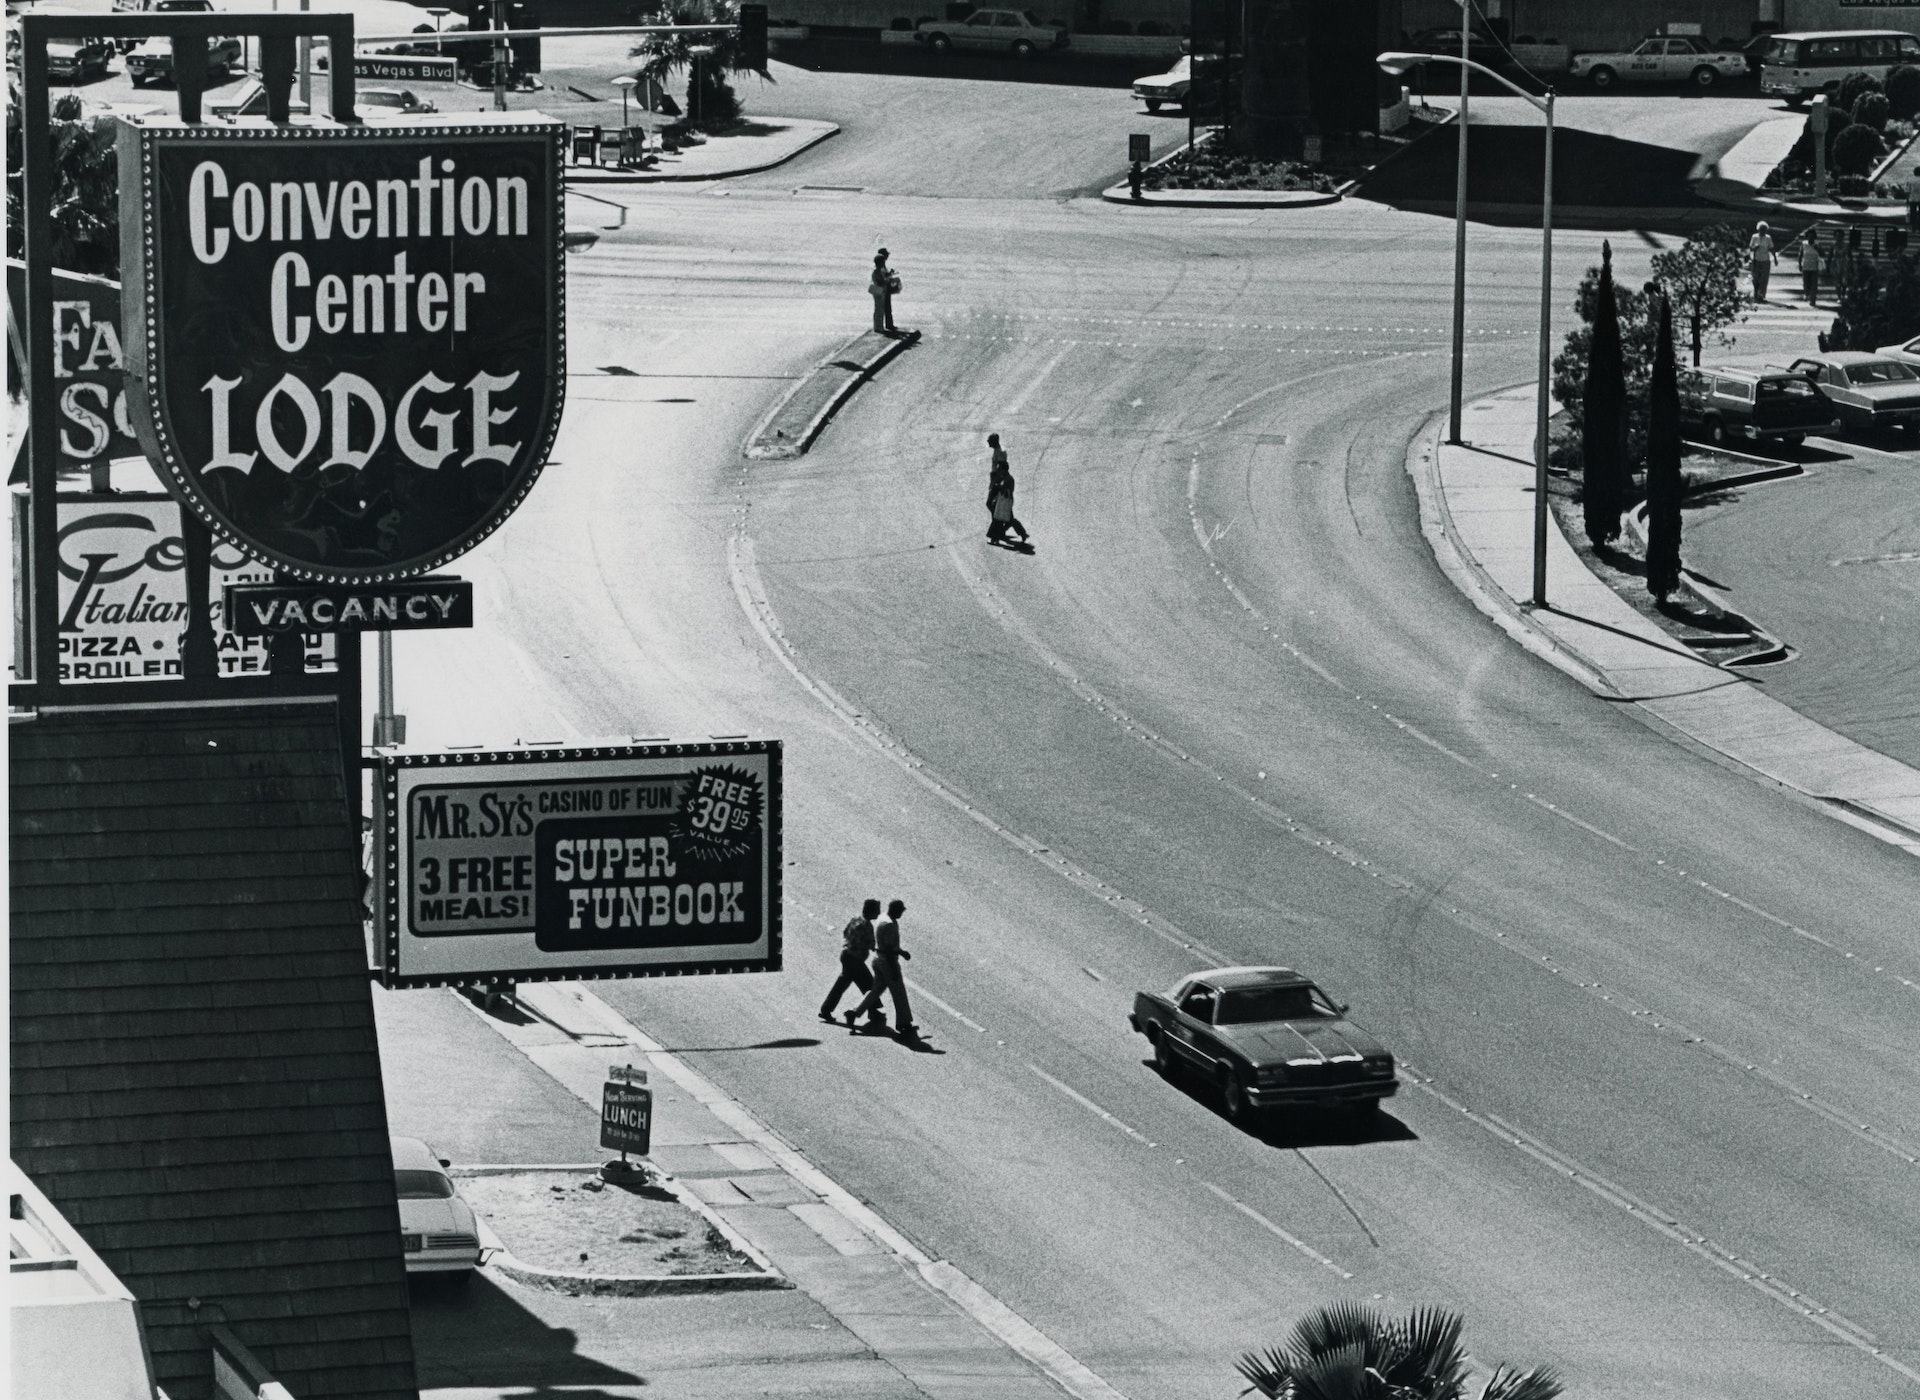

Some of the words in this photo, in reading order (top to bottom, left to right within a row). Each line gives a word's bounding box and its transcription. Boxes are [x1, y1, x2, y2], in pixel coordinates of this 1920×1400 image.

[372, 64, 414, 79] Vegas
[422, 66, 452, 78] Blvd
[189, 155, 529, 264] Convention
[270, 250, 486, 353] Center
[200, 370, 523, 475] LODGE
[250, 594, 459, 626] VACANCY
[538, 790, 603, 814] CASINO
[608, 788, 631, 811] OF
[636, 786, 673, 808] FUN
[697, 774, 753, 806] FREE
[689, 829, 731, 846] VALUE
[419, 857, 441, 895] 3
[449, 855, 532, 894] FREE
[555, 836, 676, 882] SUPER
[420, 895, 530, 922] MEALS!
[568, 881, 745, 930] FUNBOOK
[604, 1103, 647, 1130] LUNCH
